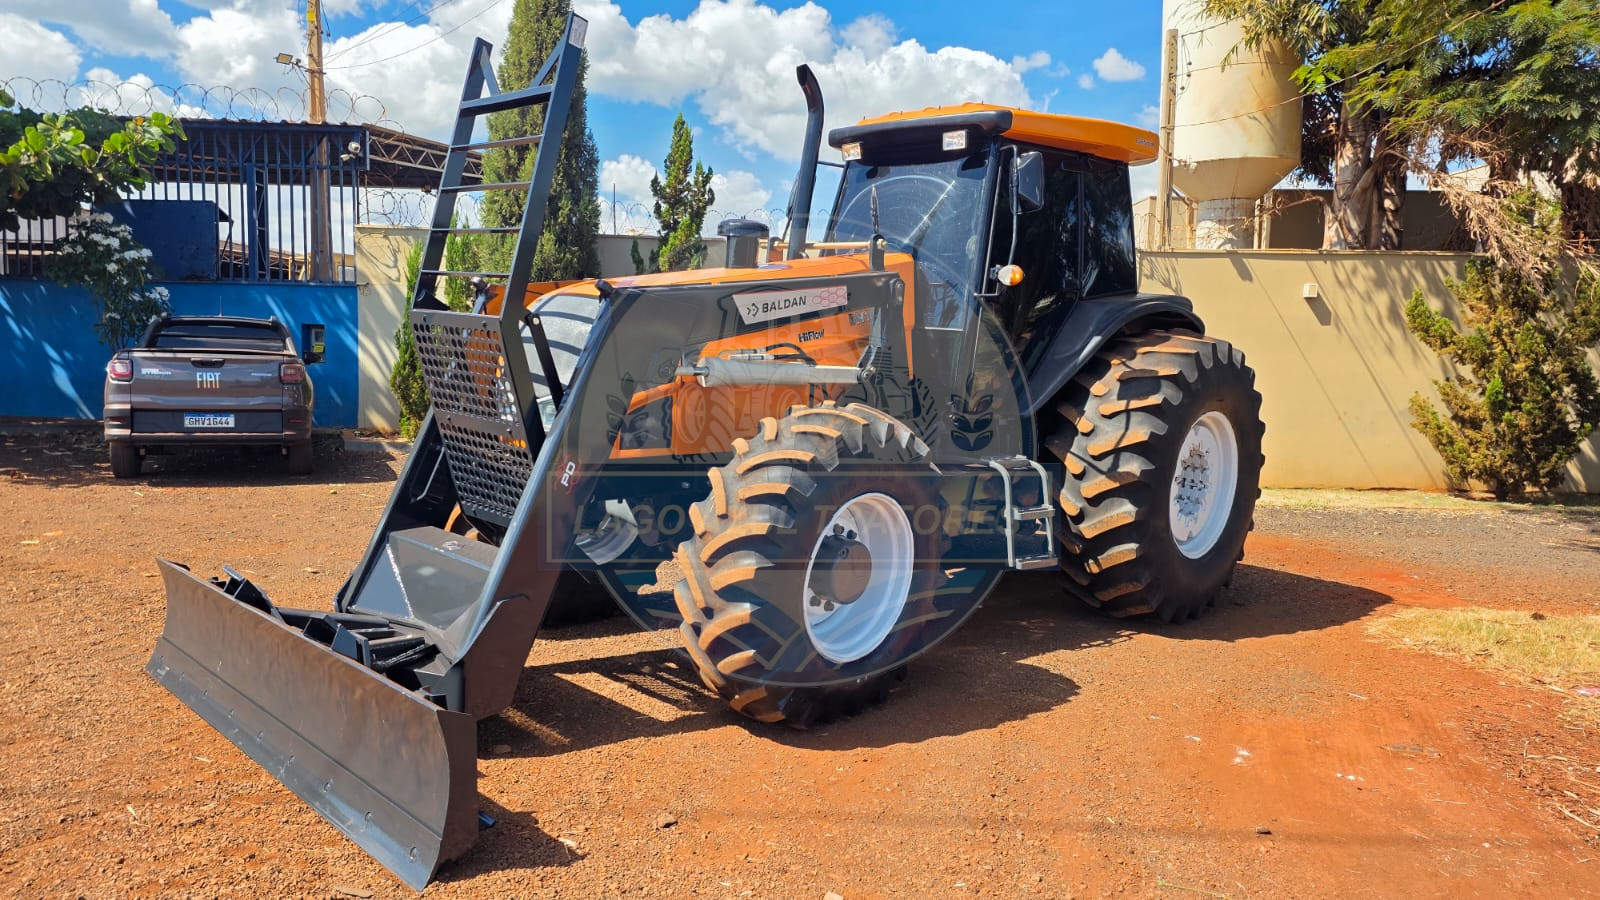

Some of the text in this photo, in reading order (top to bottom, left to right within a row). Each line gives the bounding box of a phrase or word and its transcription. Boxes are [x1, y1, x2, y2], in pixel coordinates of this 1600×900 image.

[762, 295, 806, 313] BALDAN
[798, 328, 824, 342] HiFlow
[196, 372, 221, 389] FIAT
[561, 461, 576, 487] PD
